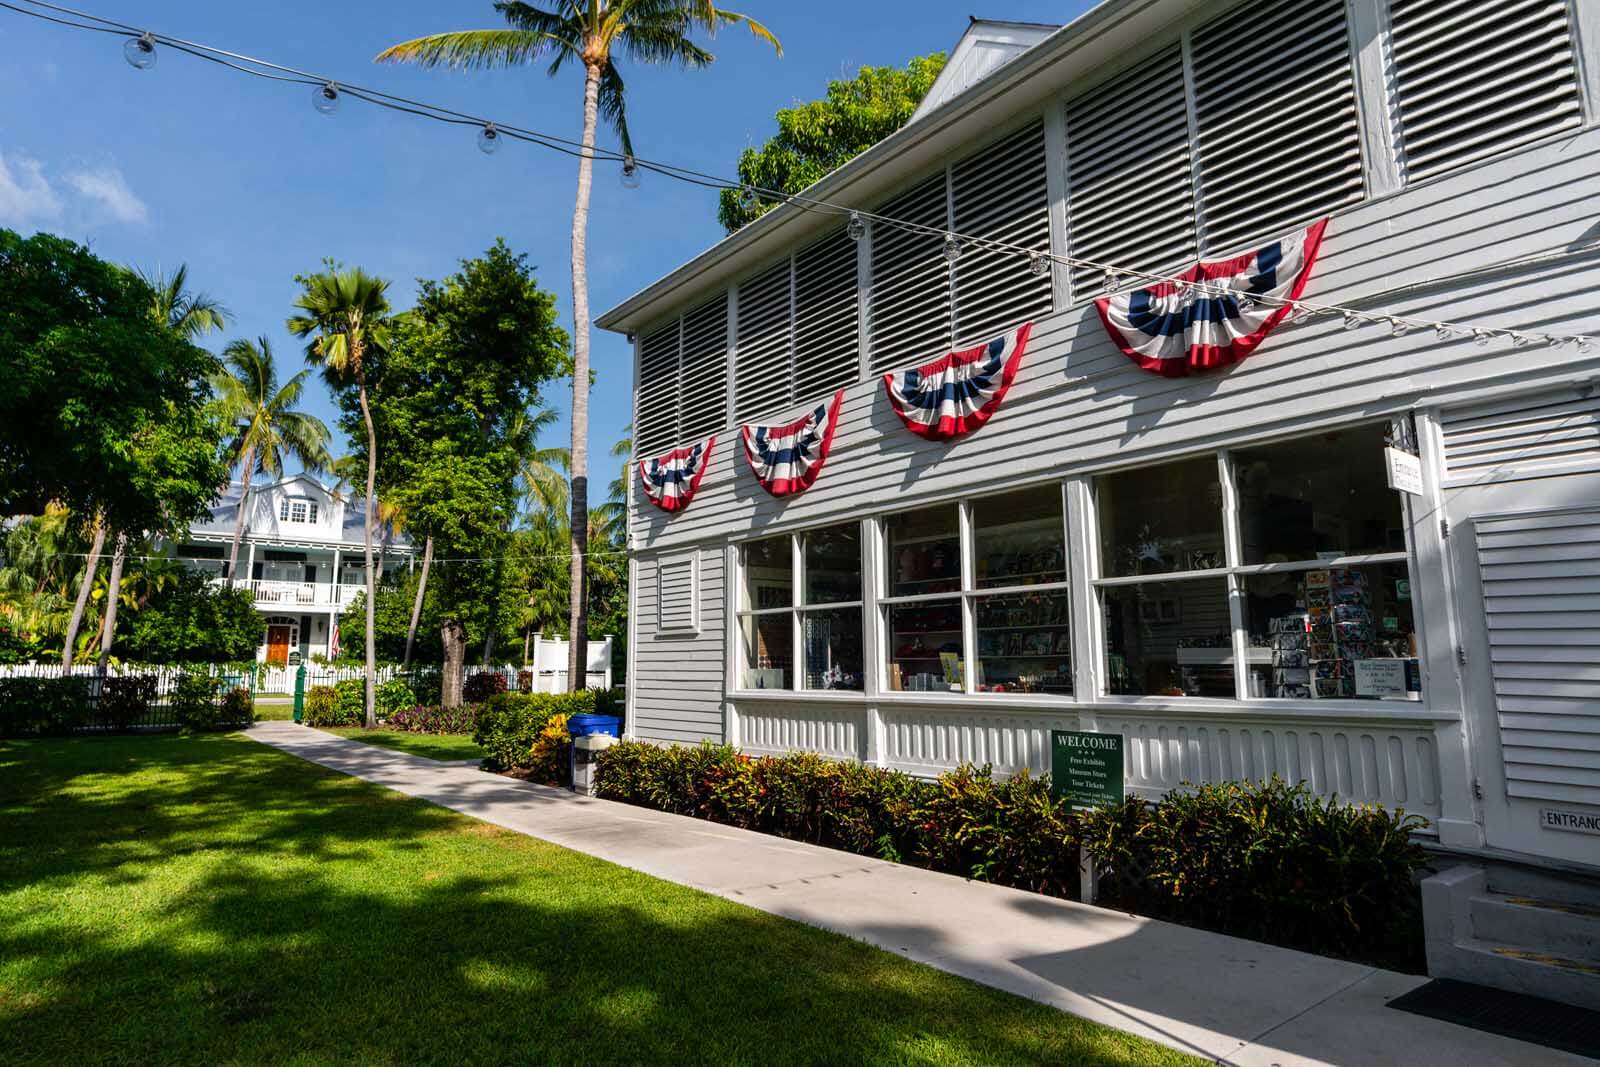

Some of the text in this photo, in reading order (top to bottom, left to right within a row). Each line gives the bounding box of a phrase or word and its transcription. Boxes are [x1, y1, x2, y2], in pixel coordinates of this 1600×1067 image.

[1057, 735, 1117, 750] WELCOME
[1070, 756, 1105, 766] Free Exhibits
[1086, 781, 1104, 789] Tickets
